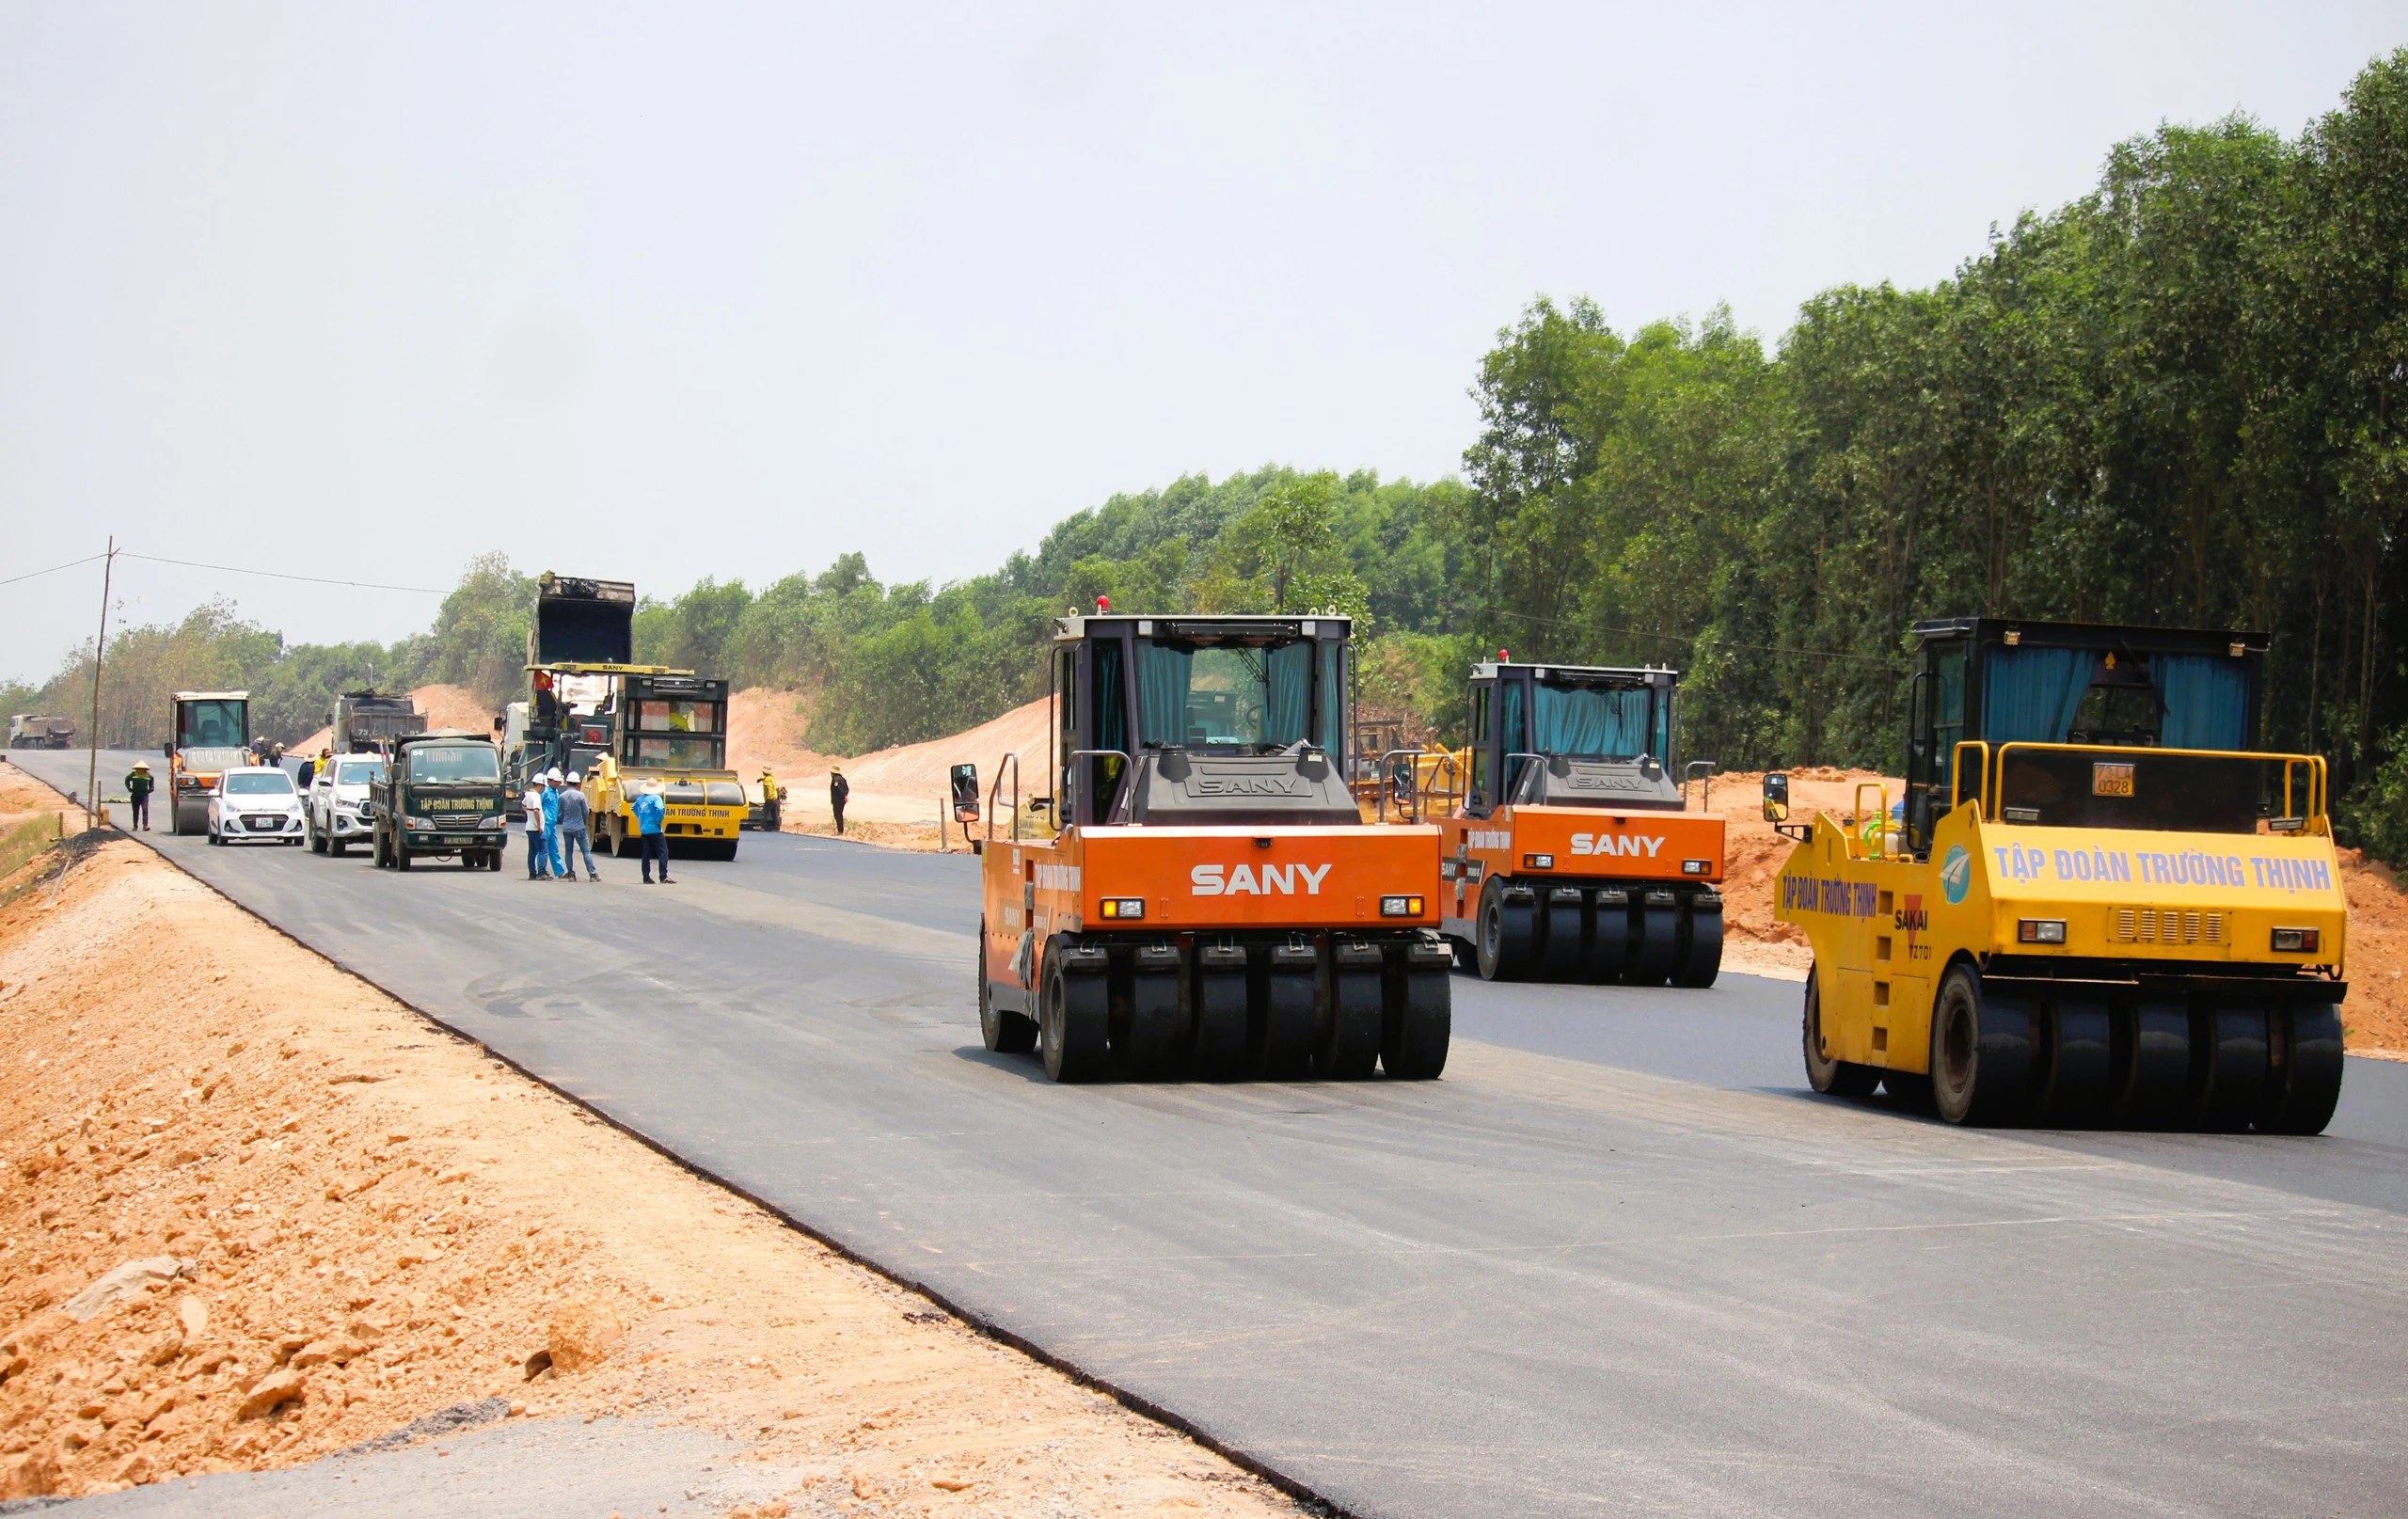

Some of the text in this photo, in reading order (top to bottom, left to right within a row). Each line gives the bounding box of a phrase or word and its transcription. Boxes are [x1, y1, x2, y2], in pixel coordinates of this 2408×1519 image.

[1198, 779, 1296, 794] SANY
[1576, 778, 1641, 789] SANY
[2099, 780, 2129, 794] 0328
[476, 798, 494, 811] THỊNH
[708, 809, 730, 819] THỊNH
[1571, 832, 1666, 858] SANY
[1442, 862, 1457, 877] SANY
[1993, 842, 2332, 894] TẬP ĐOÀN TRƯỜNG THỊNH
[1191, 863, 1333, 895] SANY
[1782, 869, 1877, 924] TẬP ĐOÀN TRƯỜNG THỊNH
[1005, 906, 1021, 927] SANY
[1894, 910, 1927, 931] SAKAI
